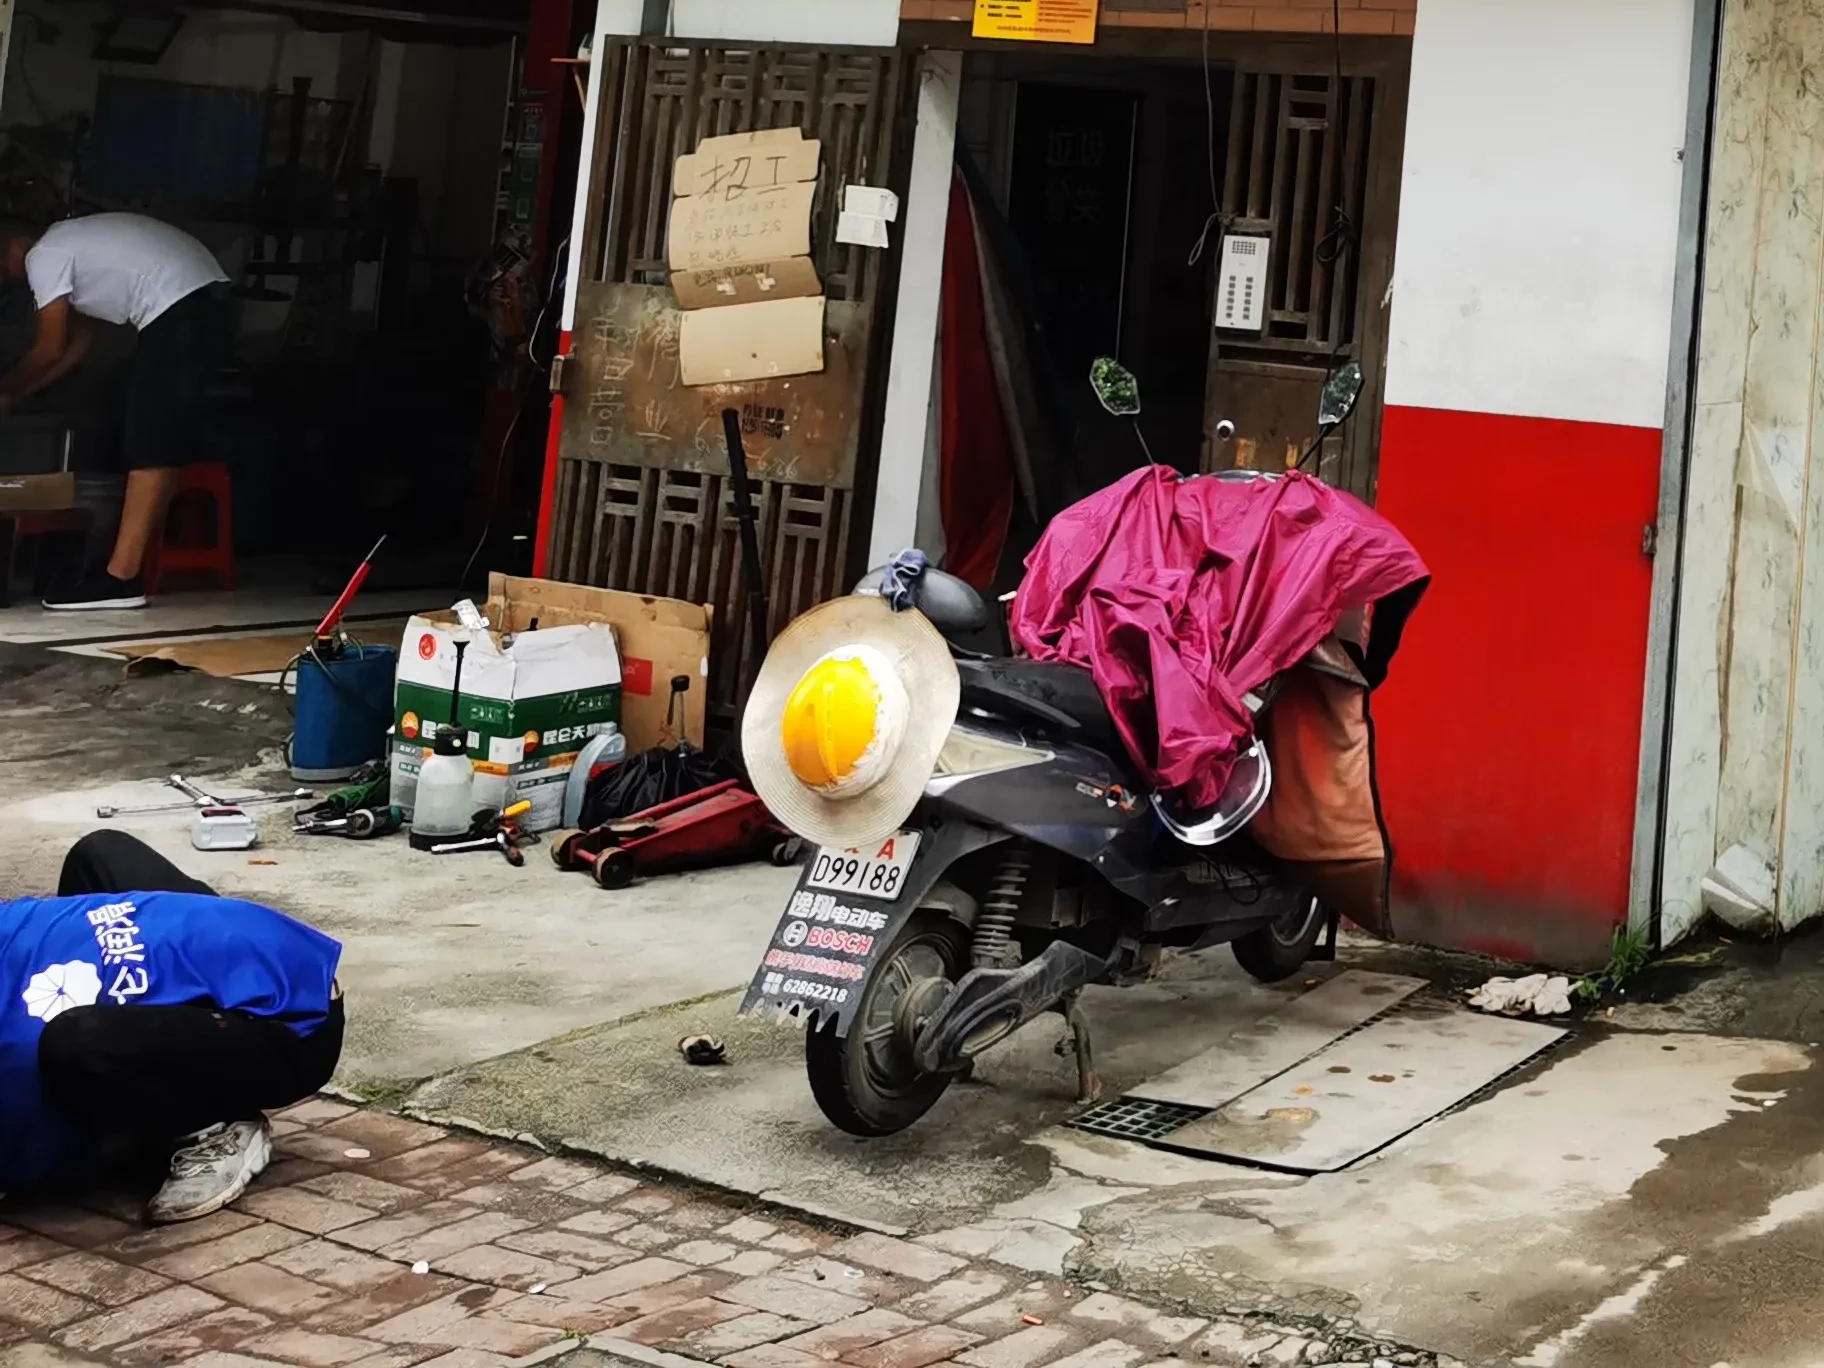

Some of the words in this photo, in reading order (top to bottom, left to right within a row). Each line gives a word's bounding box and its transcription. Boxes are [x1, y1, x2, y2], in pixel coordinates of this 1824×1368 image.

[700, 154, 788, 202] 招工
[876, 838, 896, 861] A
[805, 925, 874, 957] BOSCH
[782, 978, 849, 1004] 62862218
